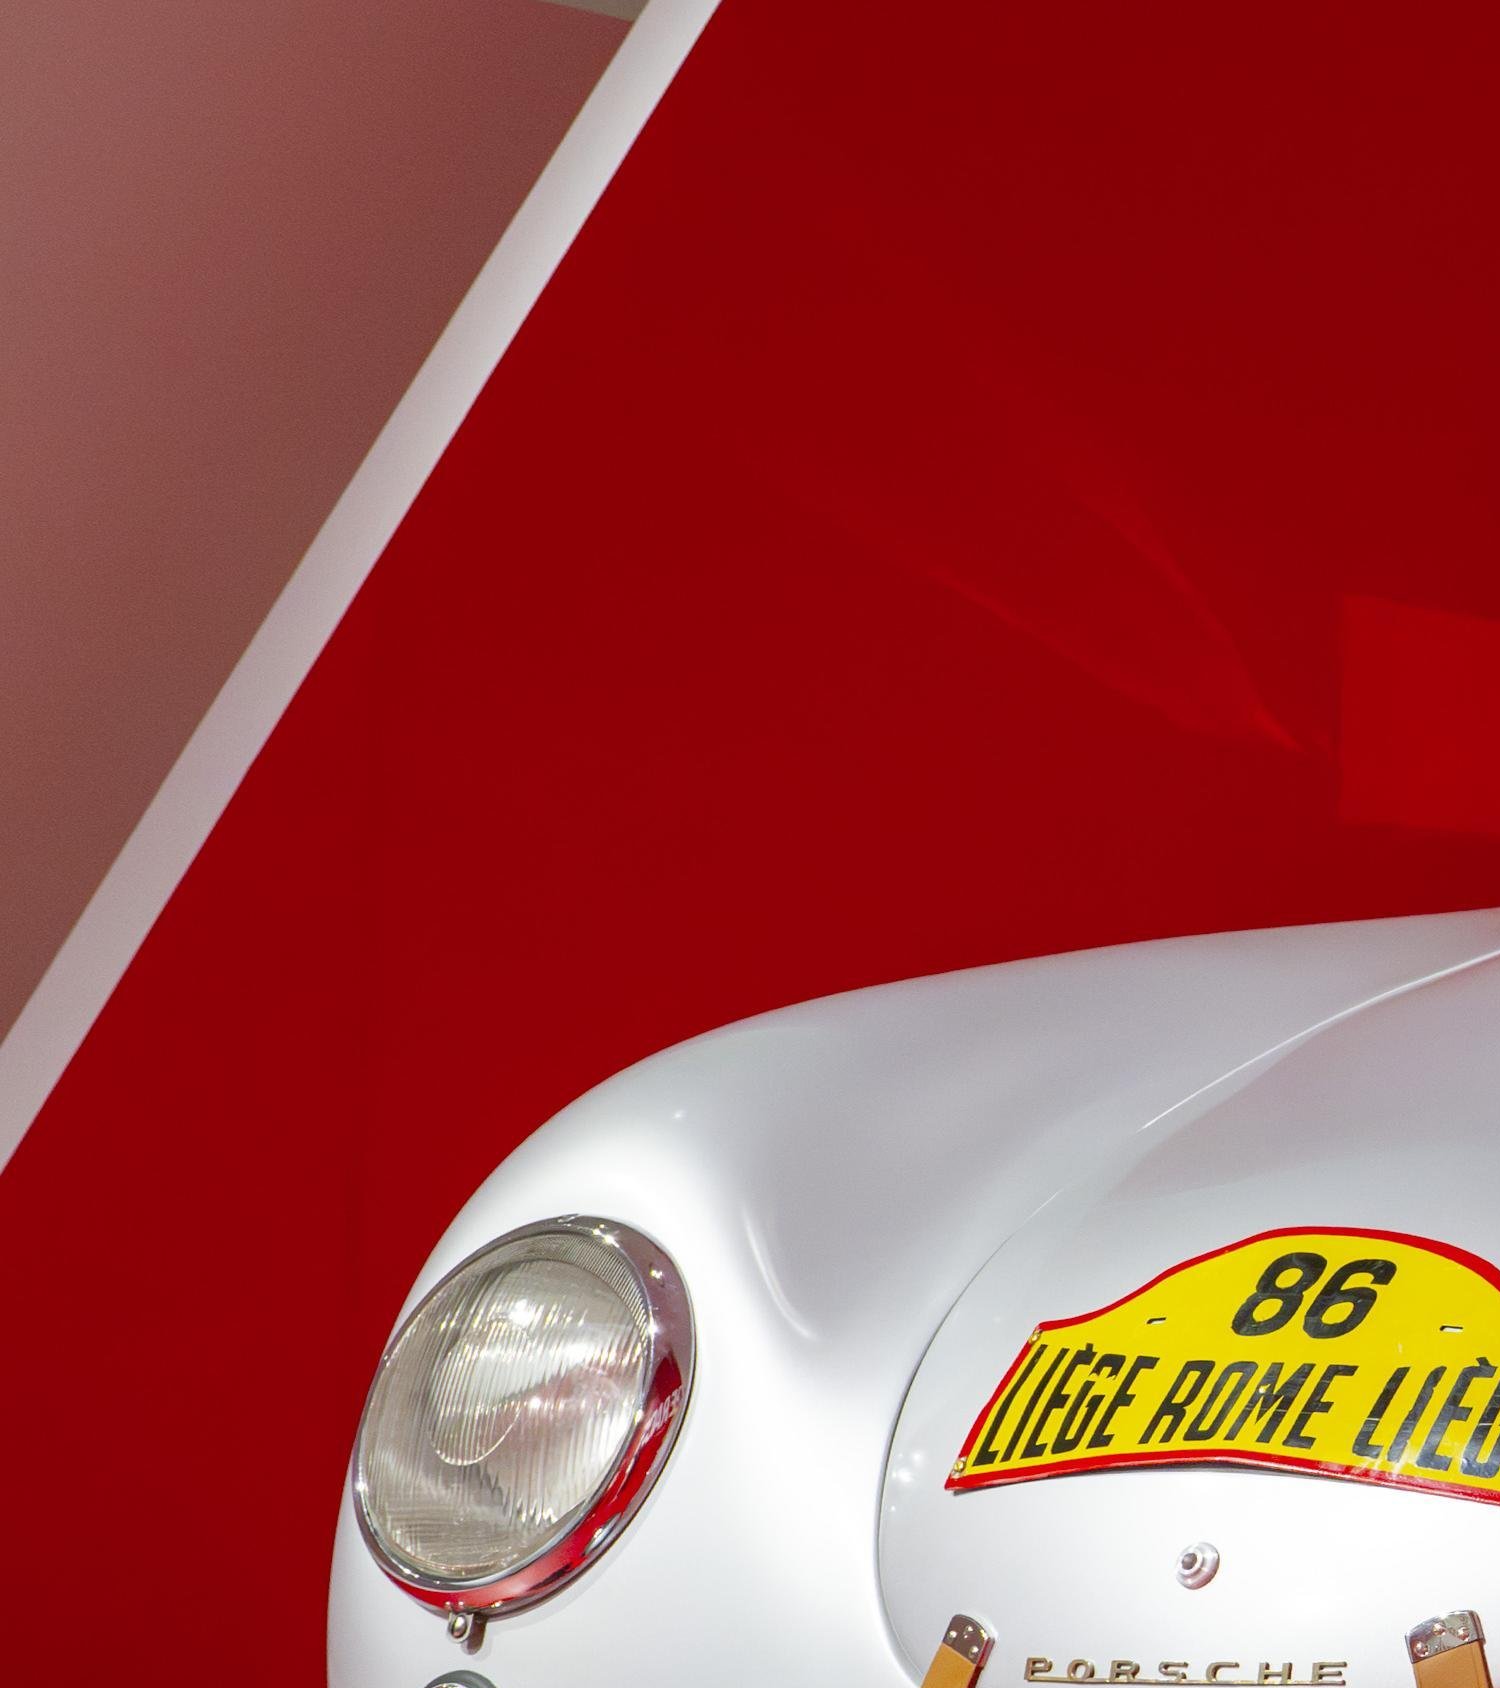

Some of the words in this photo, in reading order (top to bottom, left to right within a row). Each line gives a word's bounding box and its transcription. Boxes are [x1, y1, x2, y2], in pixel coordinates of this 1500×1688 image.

[1230, 1250, 1398, 1340] 86
[1138, 1359, 1359, 1451] ROME
[1025, 1656, 1347, 1686] PORSCHE
